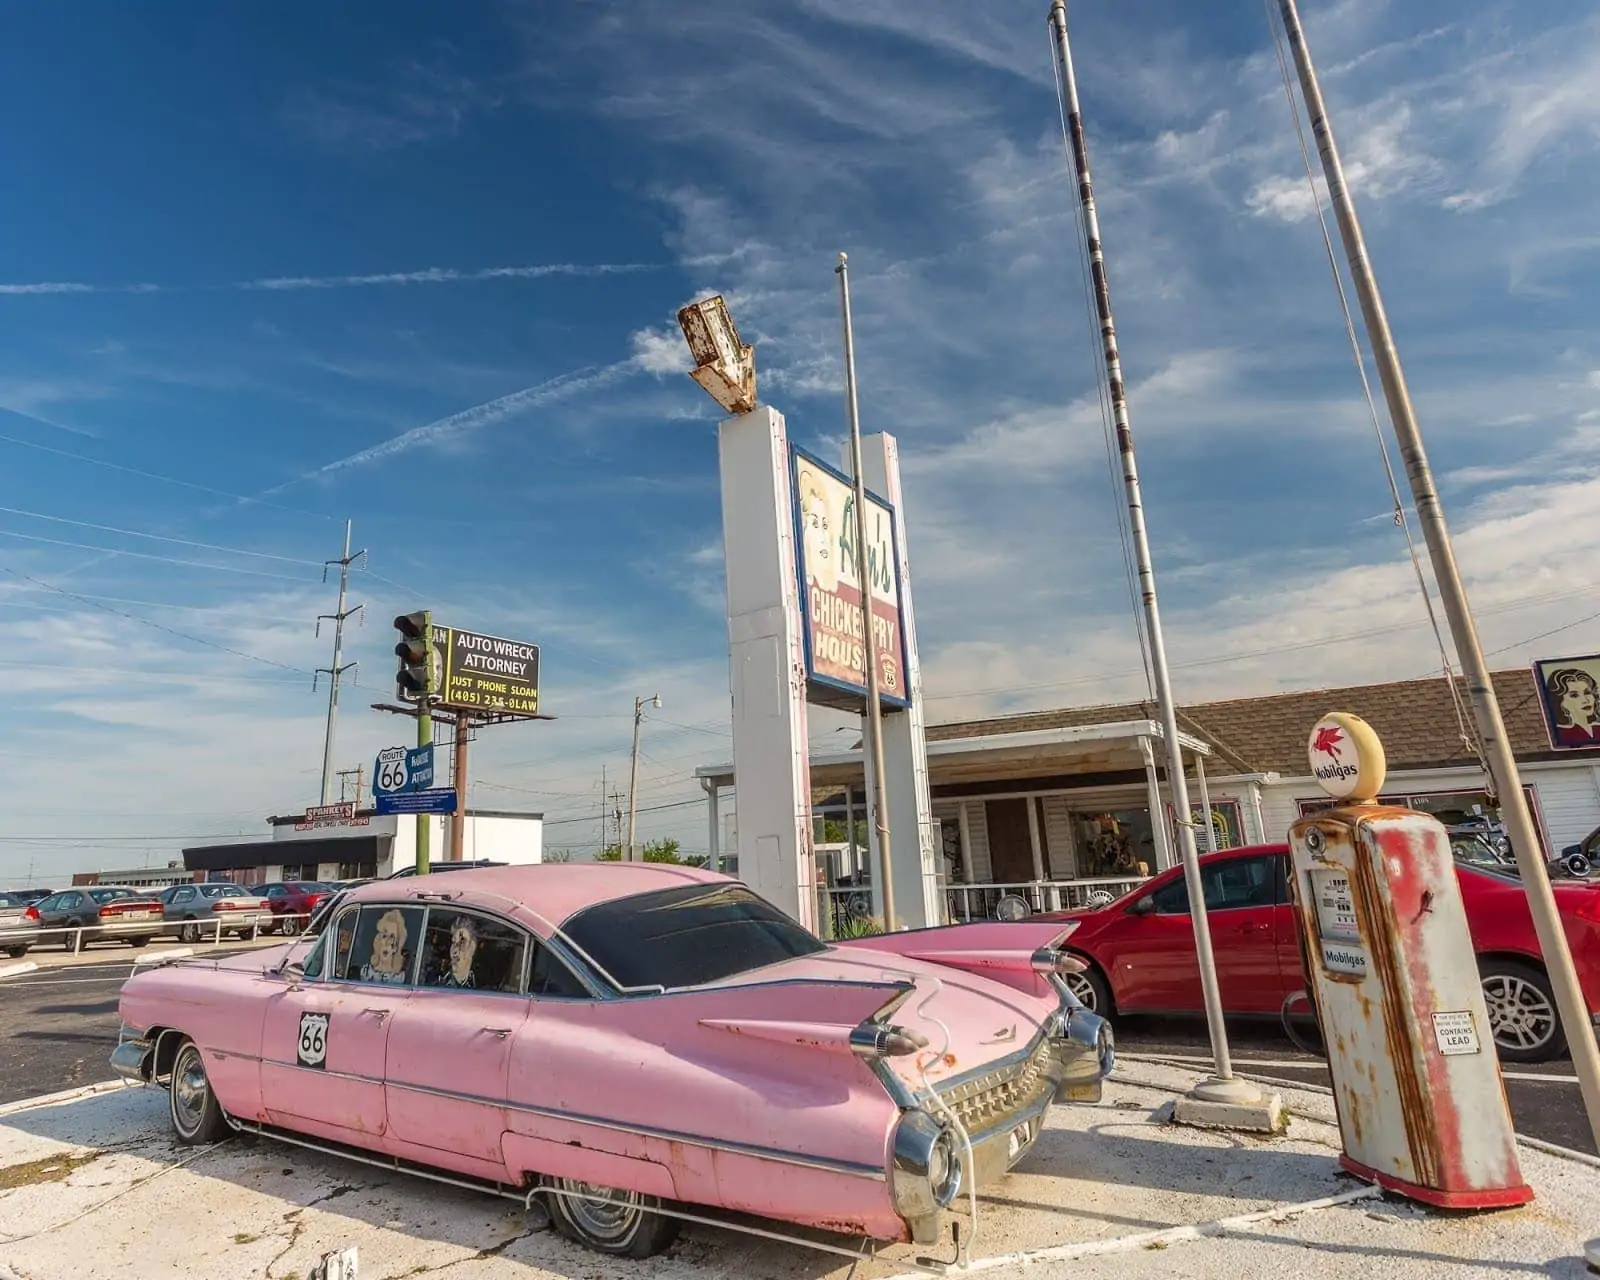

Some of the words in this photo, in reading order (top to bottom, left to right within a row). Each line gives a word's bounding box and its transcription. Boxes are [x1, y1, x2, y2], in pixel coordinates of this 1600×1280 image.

[872, 613, 895, 652] FRY
[457, 634, 492, 652] AUTO
[494, 640, 534, 661] WRECK
[815, 630, 864, 671] HOUS
[464, 652, 527, 676] ATTORNEY
[450, 675, 473, 688] JUST
[477, 679, 507, 694] PHONE
[510, 685, 537, 698] SLOAN
[450, 689, 480, 705] (405)
[382, 750, 404, 761] ROUTE
[381, 761, 404, 789] 66
[1314, 764, 1358, 781] Mobilgas
[1325, 950, 1366, 968] Mobilgas
[301, 1024, 323, 1053] 66
[1439, 1027, 1473, 1036] CONTAINS
[1446, 1036, 1470, 1046] LEAD
